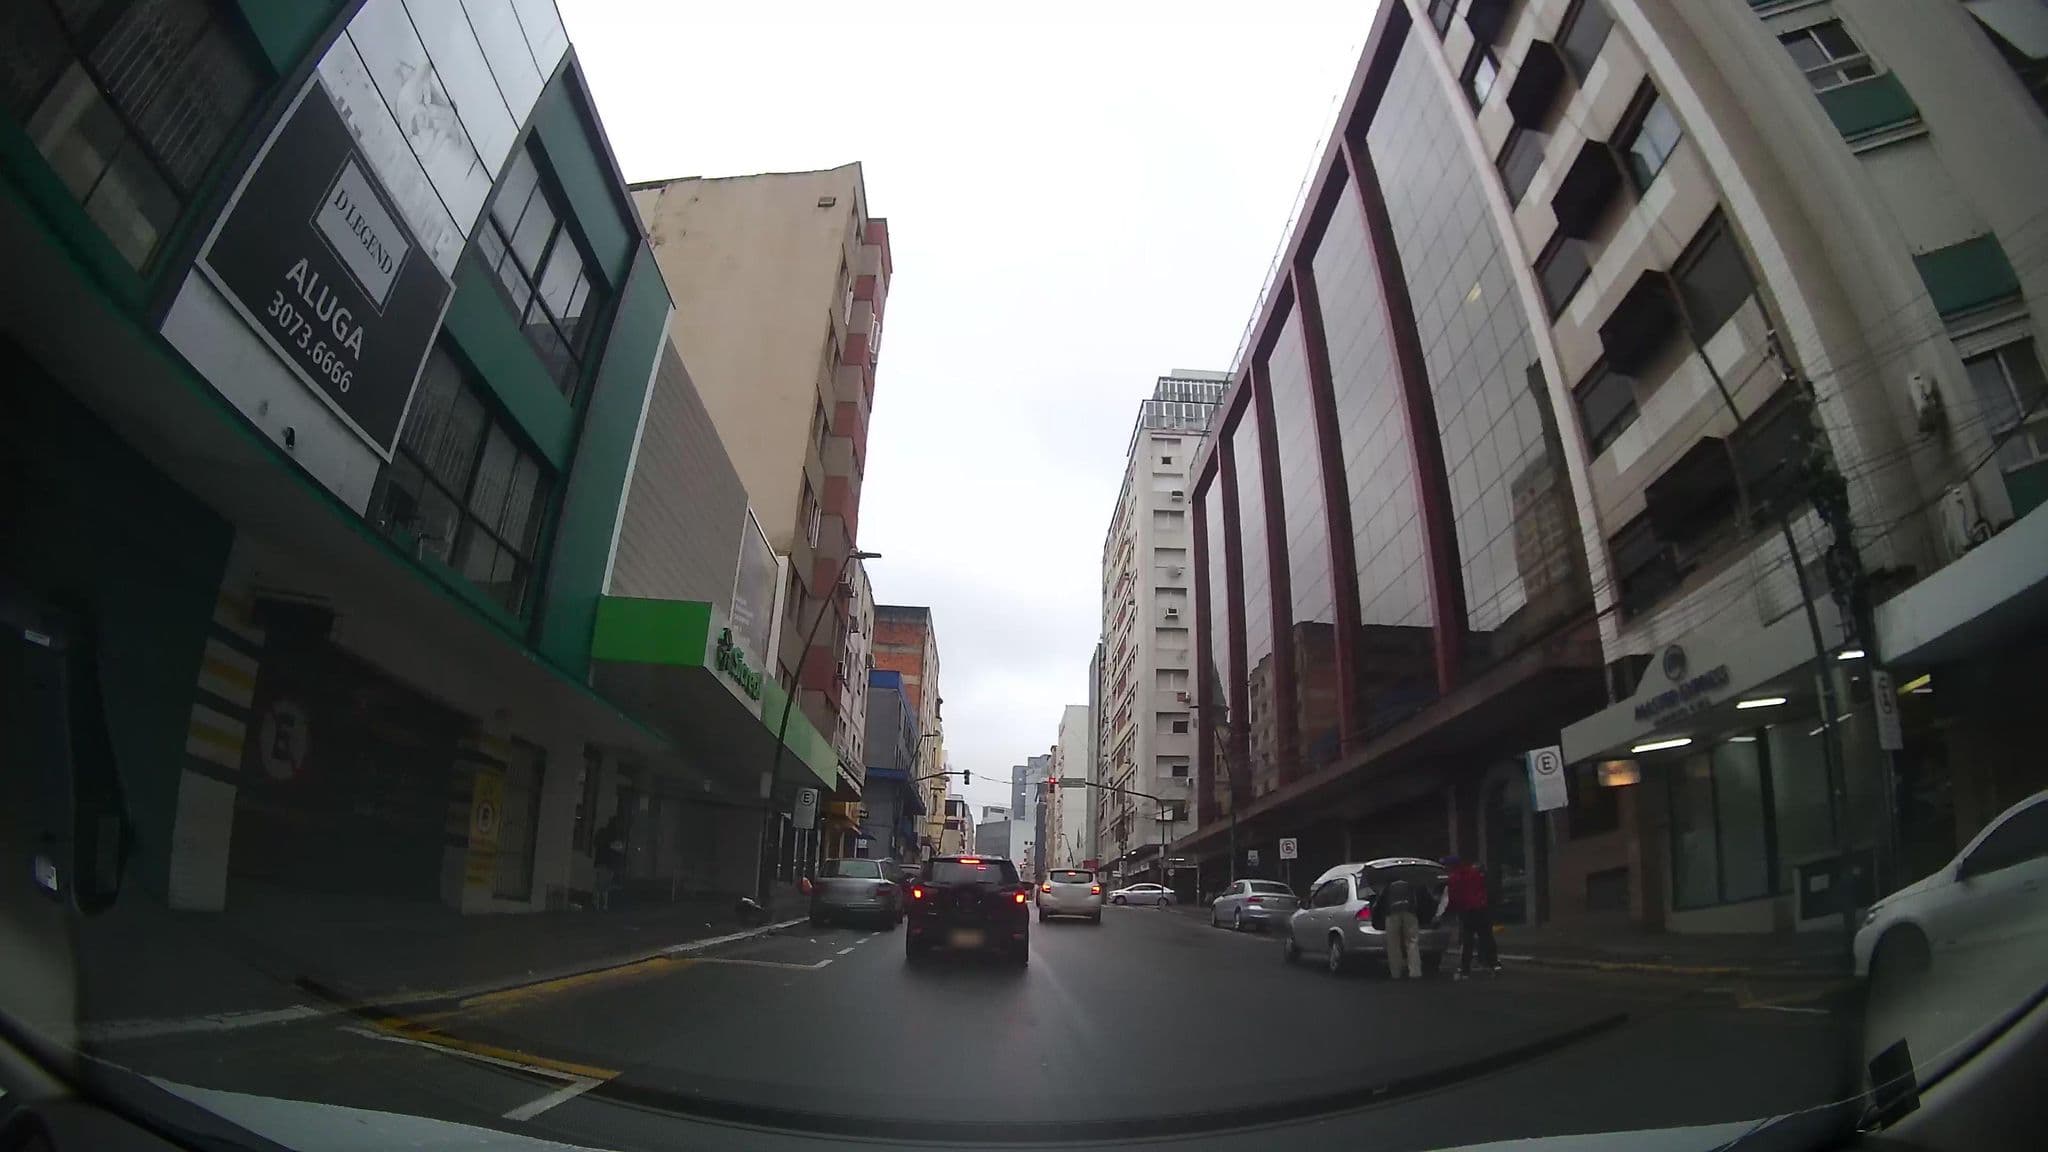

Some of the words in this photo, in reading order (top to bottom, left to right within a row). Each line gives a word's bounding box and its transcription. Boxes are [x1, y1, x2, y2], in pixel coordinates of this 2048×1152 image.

[285, 257, 365, 361] ALUGA
[267, 290, 354, 393] 3073.6666
[1541, 755, 1553, 771] E
[803, 793, 811, 803] E
